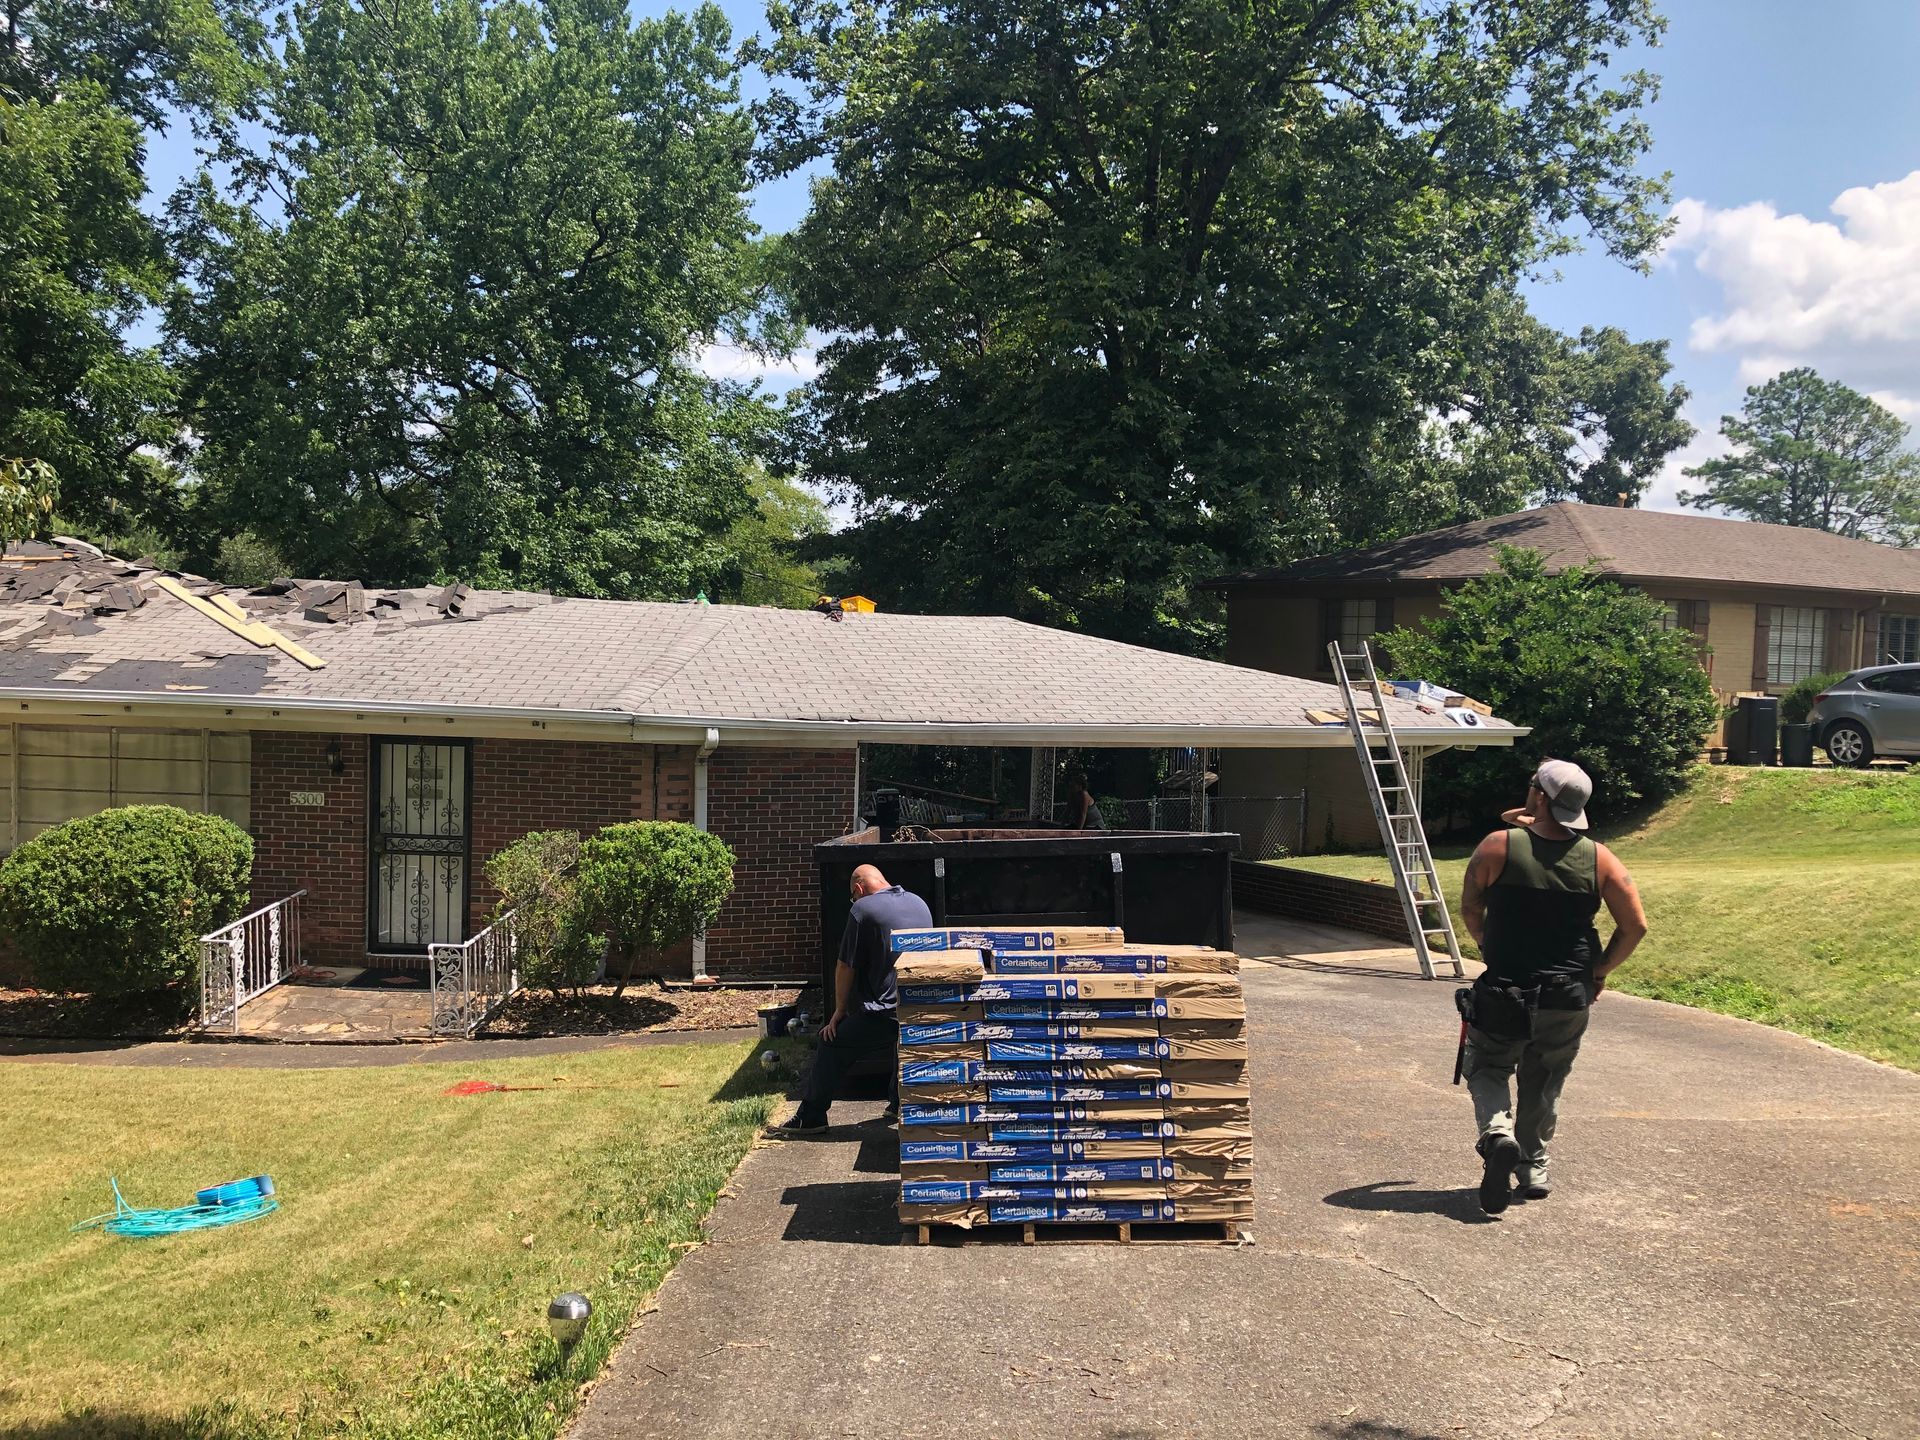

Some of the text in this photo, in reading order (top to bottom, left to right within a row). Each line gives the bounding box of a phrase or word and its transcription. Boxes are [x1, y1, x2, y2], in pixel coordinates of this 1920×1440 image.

[290, 793, 323, 805] 5300
[897, 936, 942, 945] CertainTeed
[1001, 958, 1049, 967] CertainTeed
[1090, 963, 1104, 971] 25
[905, 989, 954, 997] CertainTeed
[996, 991, 1012, 999] 25
[992, 1005, 1042, 1014] CertainTeed
[1085, 1011, 1100, 1019] 25
[907, 1028, 957, 1037] CertainTeed
[997, 1045, 1046, 1054] CertainTeed
[1089, 1049, 1104, 1060] 25
[910, 1067, 959, 1077] CertainTeed
[997, 1088, 1046, 1096] CertainTeed
[1089, 1091, 1105, 1100] 25
[910, 1108, 959, 1117] CertainTeed
[1003, 1112, 1019, 1120] 25
[999, 1123, 1048, 1132] CertainTeed
[1091, 1130, 1107, 1139] 25
[907, 1145, 958, 1153] CertainTeed
[1001, 1147, 1018, 1156] 25
[997, 1168, 1047, 1178] CertainTeed
[1090, 1172, 1106, 1181] 25
[910, 1189, 961, 1198] CertainTeed
[997, 1206, 1048, 1215] CertainTeed
[1090, 1210, 1107, 1221] 25
